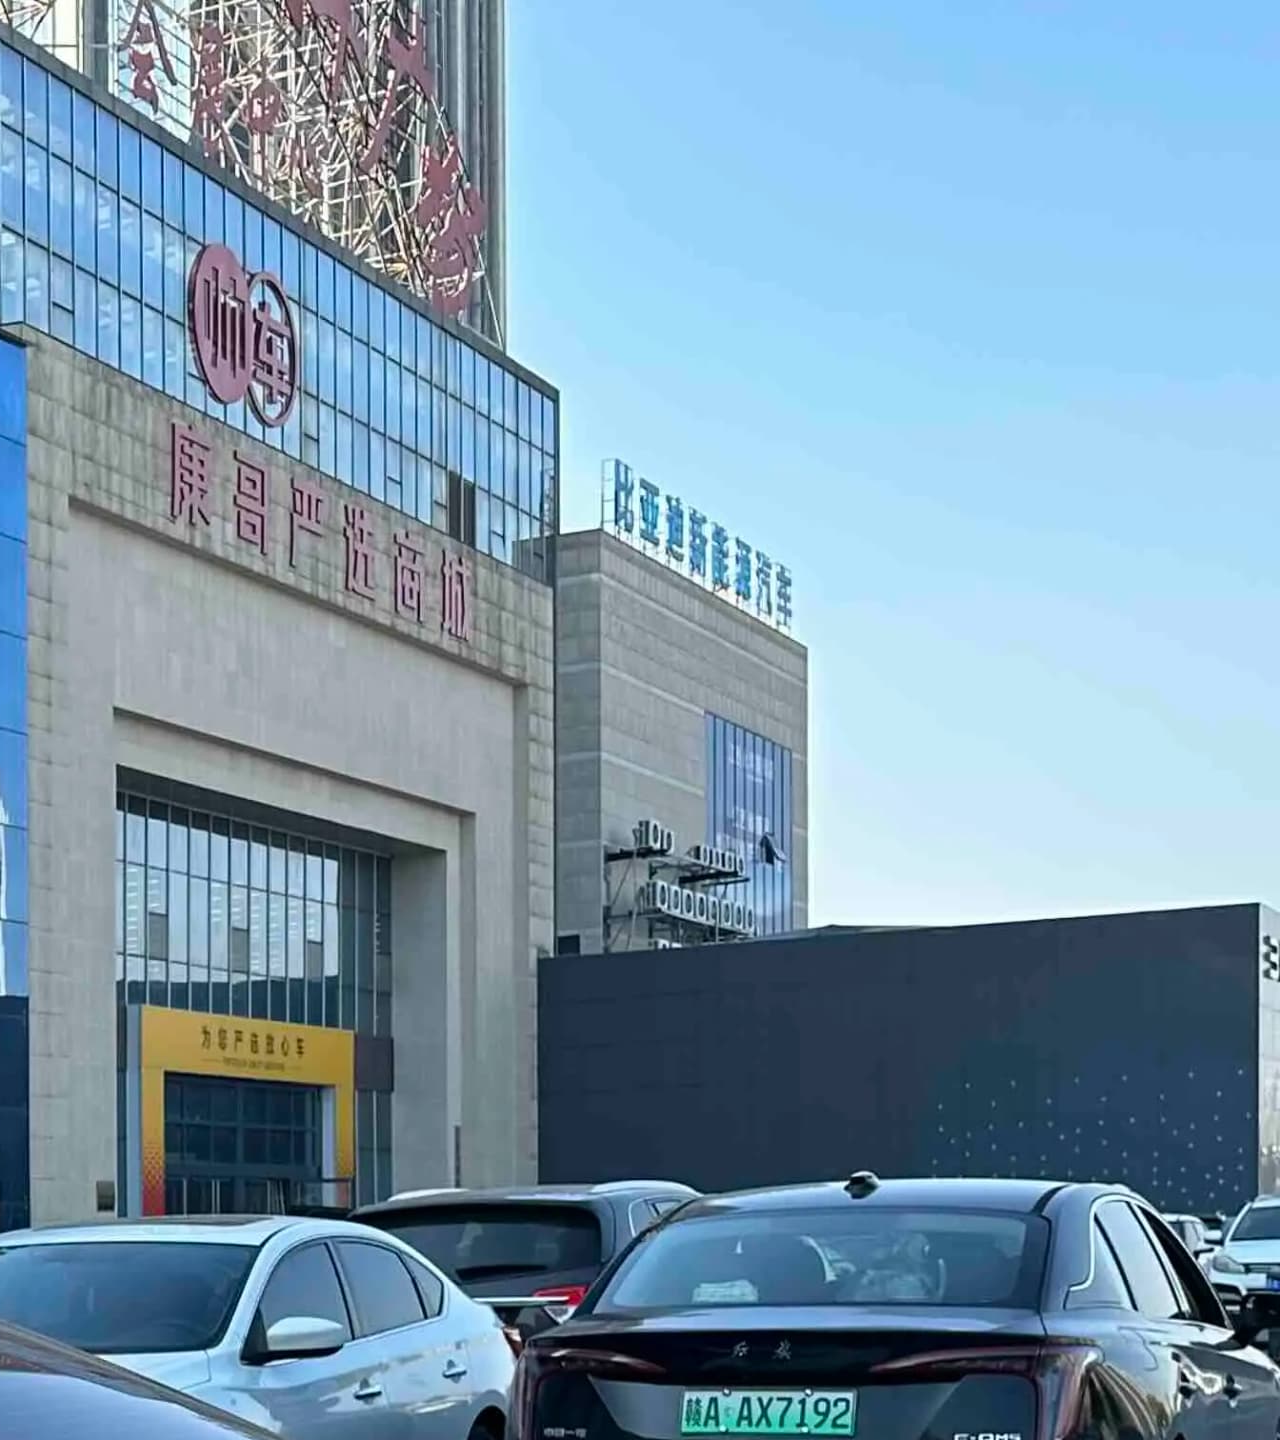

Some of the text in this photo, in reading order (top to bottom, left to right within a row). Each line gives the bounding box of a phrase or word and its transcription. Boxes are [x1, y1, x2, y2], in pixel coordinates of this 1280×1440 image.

[171, 421, 471, 642] 康哥严选商城
[614, 458, 792, 627] 比亚迪新能源汽车
